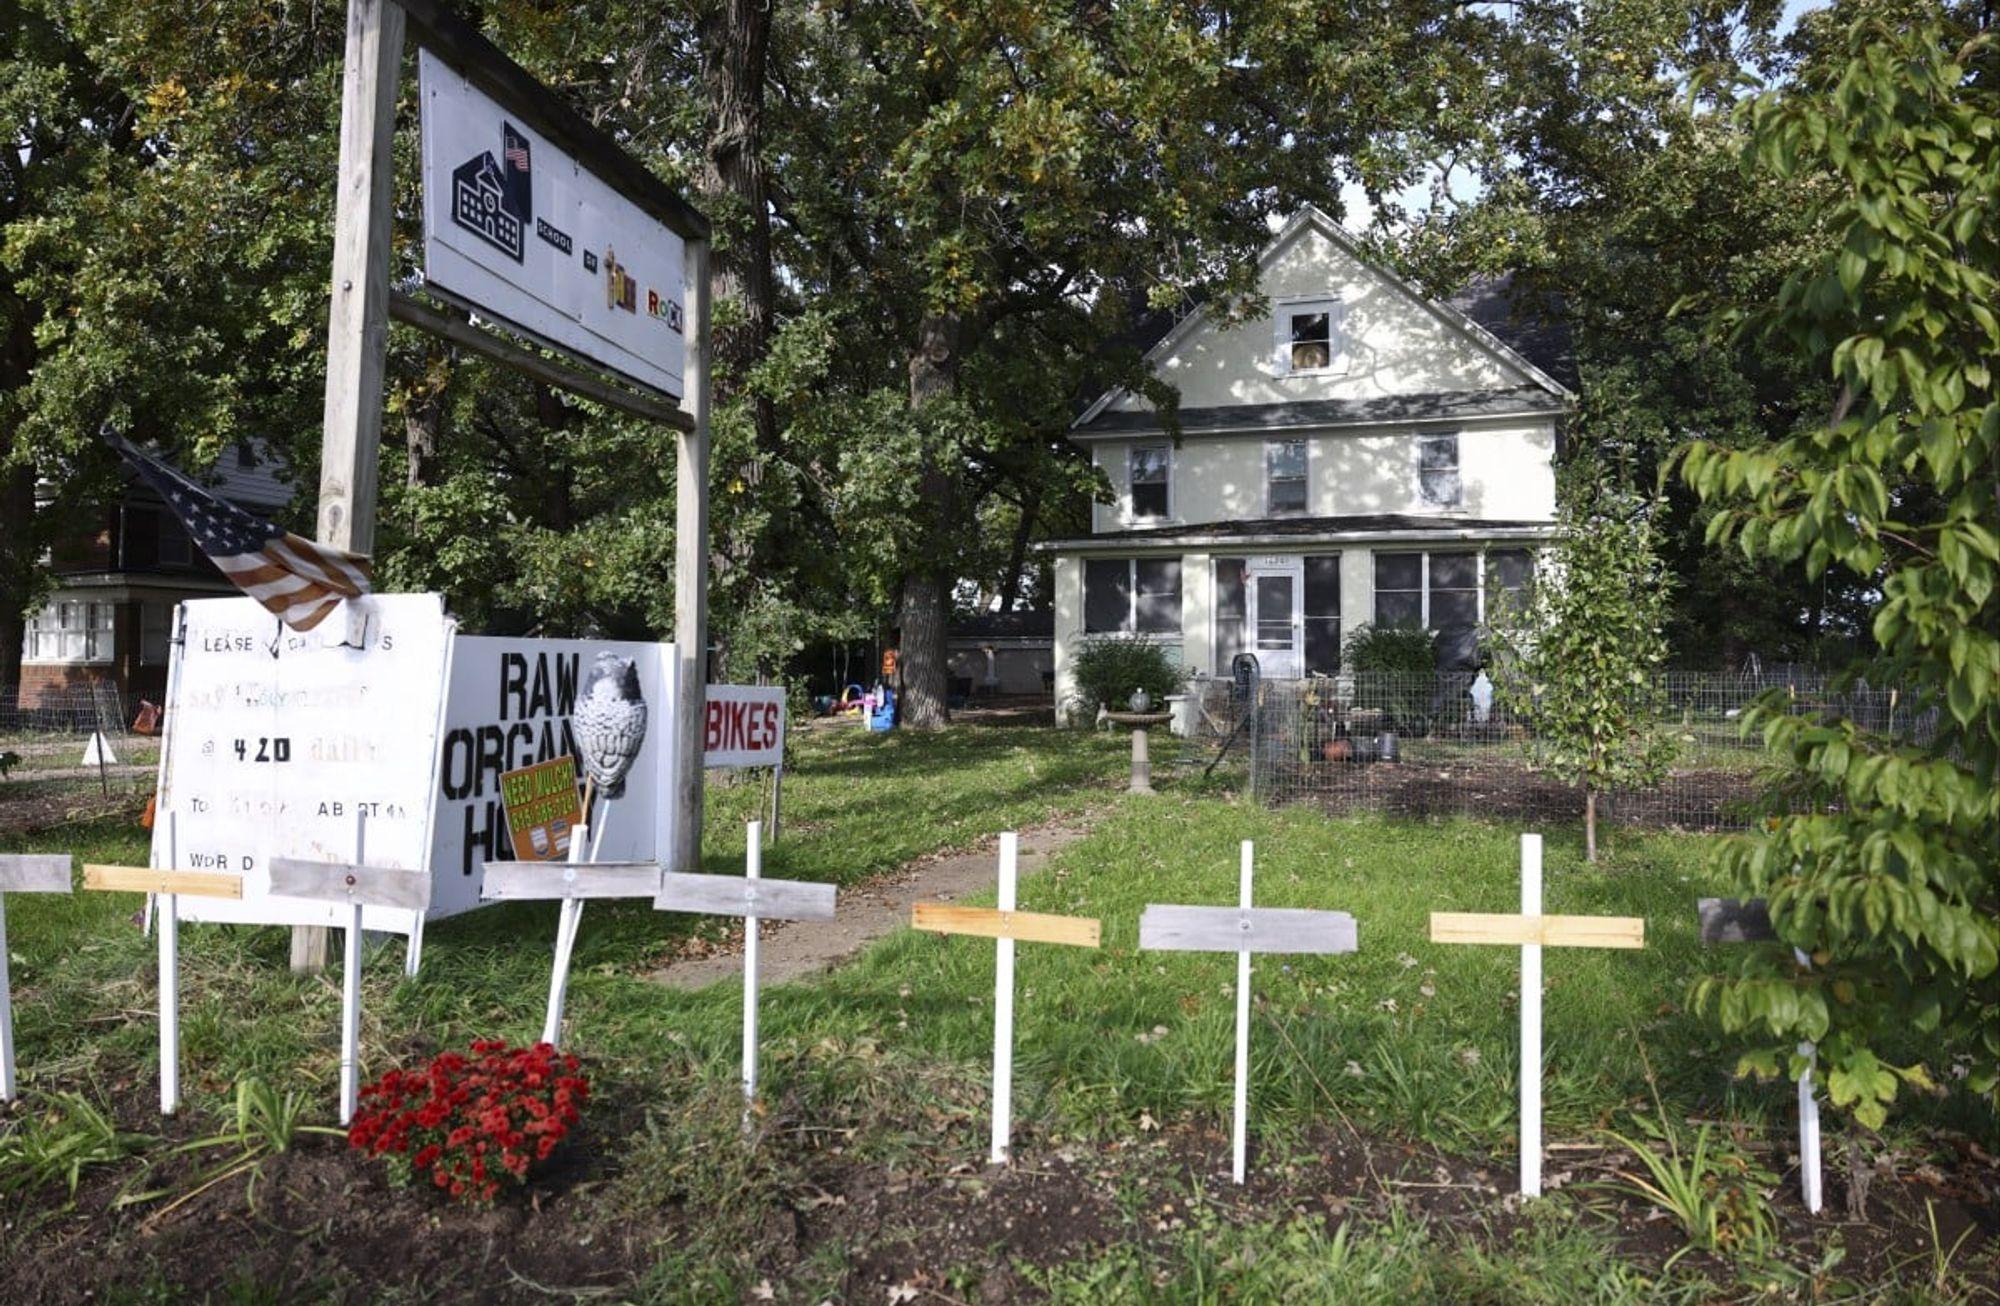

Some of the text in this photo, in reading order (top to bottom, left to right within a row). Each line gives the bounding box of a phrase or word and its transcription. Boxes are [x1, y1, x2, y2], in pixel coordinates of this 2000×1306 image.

[538, 220, 572, 252] SCHOOL
[500, 652, 579, 721] RAW
[704, 699, 778, 752] BIKES
[233, 736, 291, 763] 420
[503, 774, 533, 808] NEED
